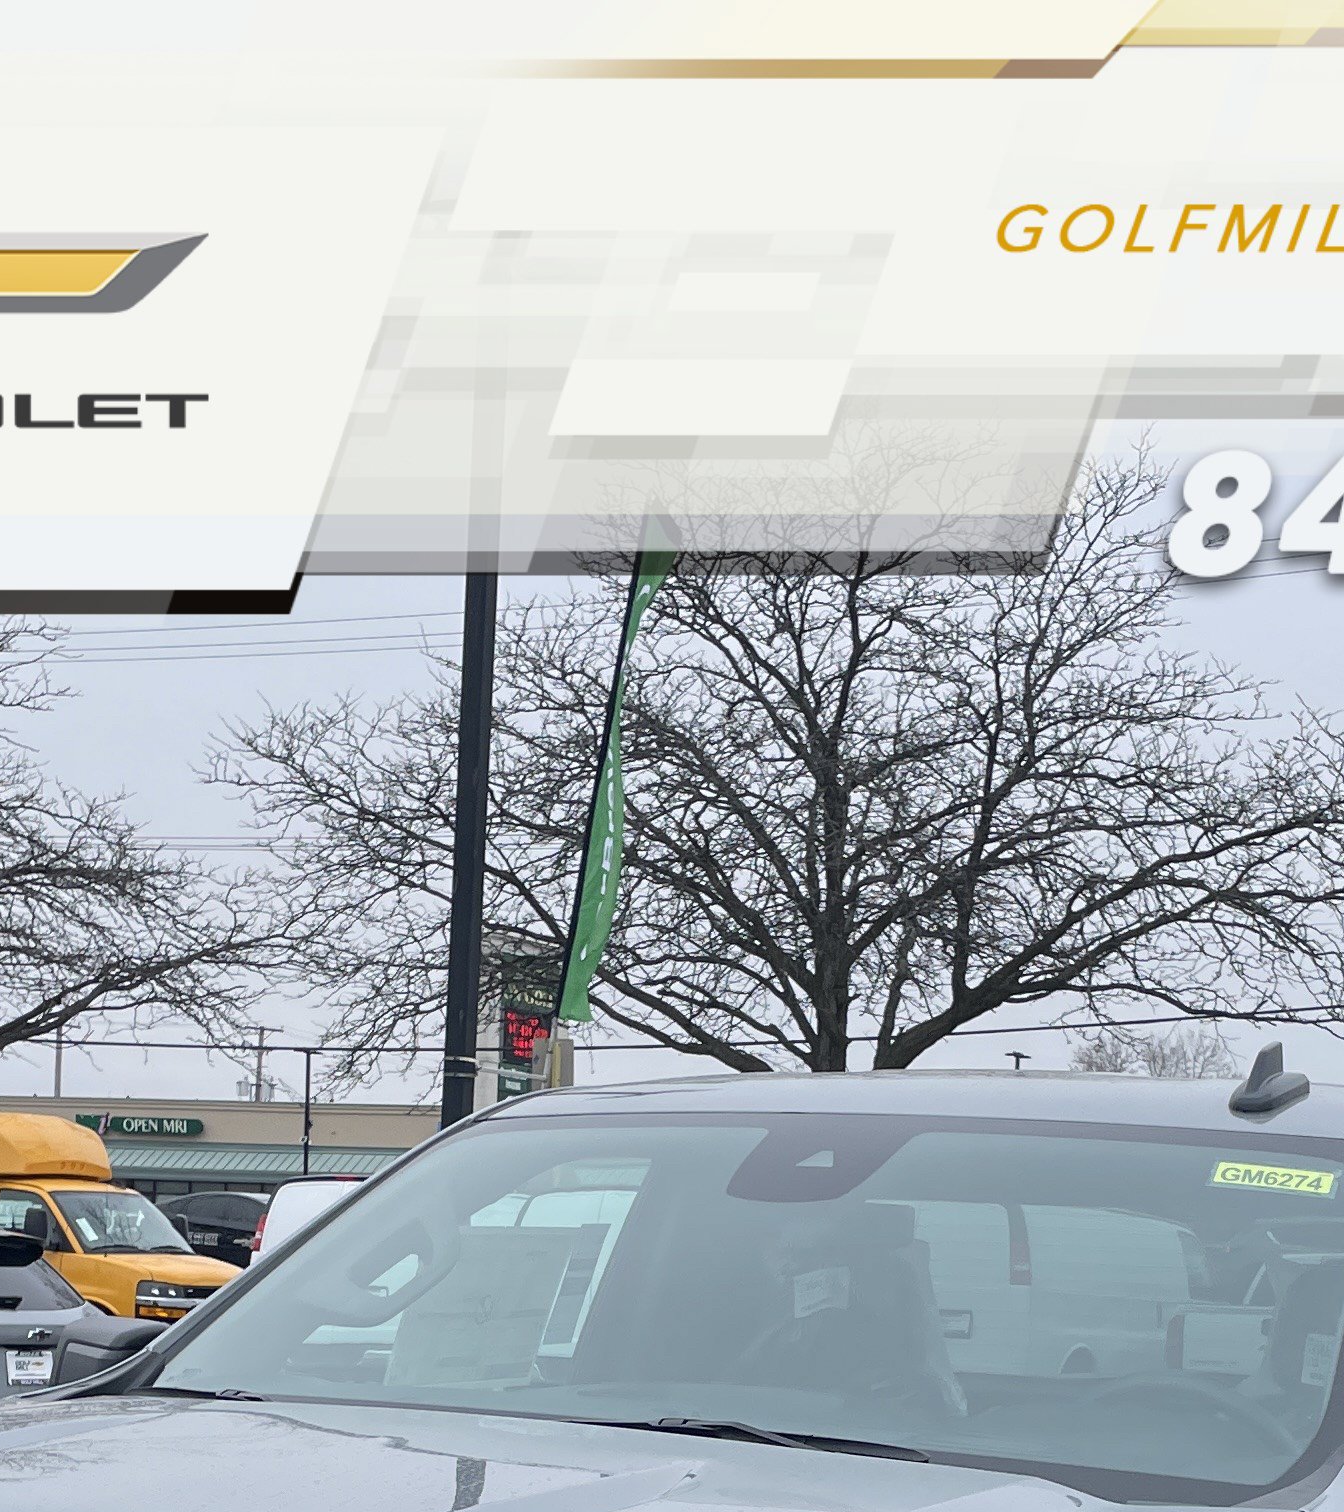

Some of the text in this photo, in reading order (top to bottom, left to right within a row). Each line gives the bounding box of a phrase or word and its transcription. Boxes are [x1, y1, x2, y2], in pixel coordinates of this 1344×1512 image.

[122, 1118, 158, 1133] OPEN
[163, 1119, 187, 1134] MRI
[1220, 1166, 1322, 1190] GM6274
